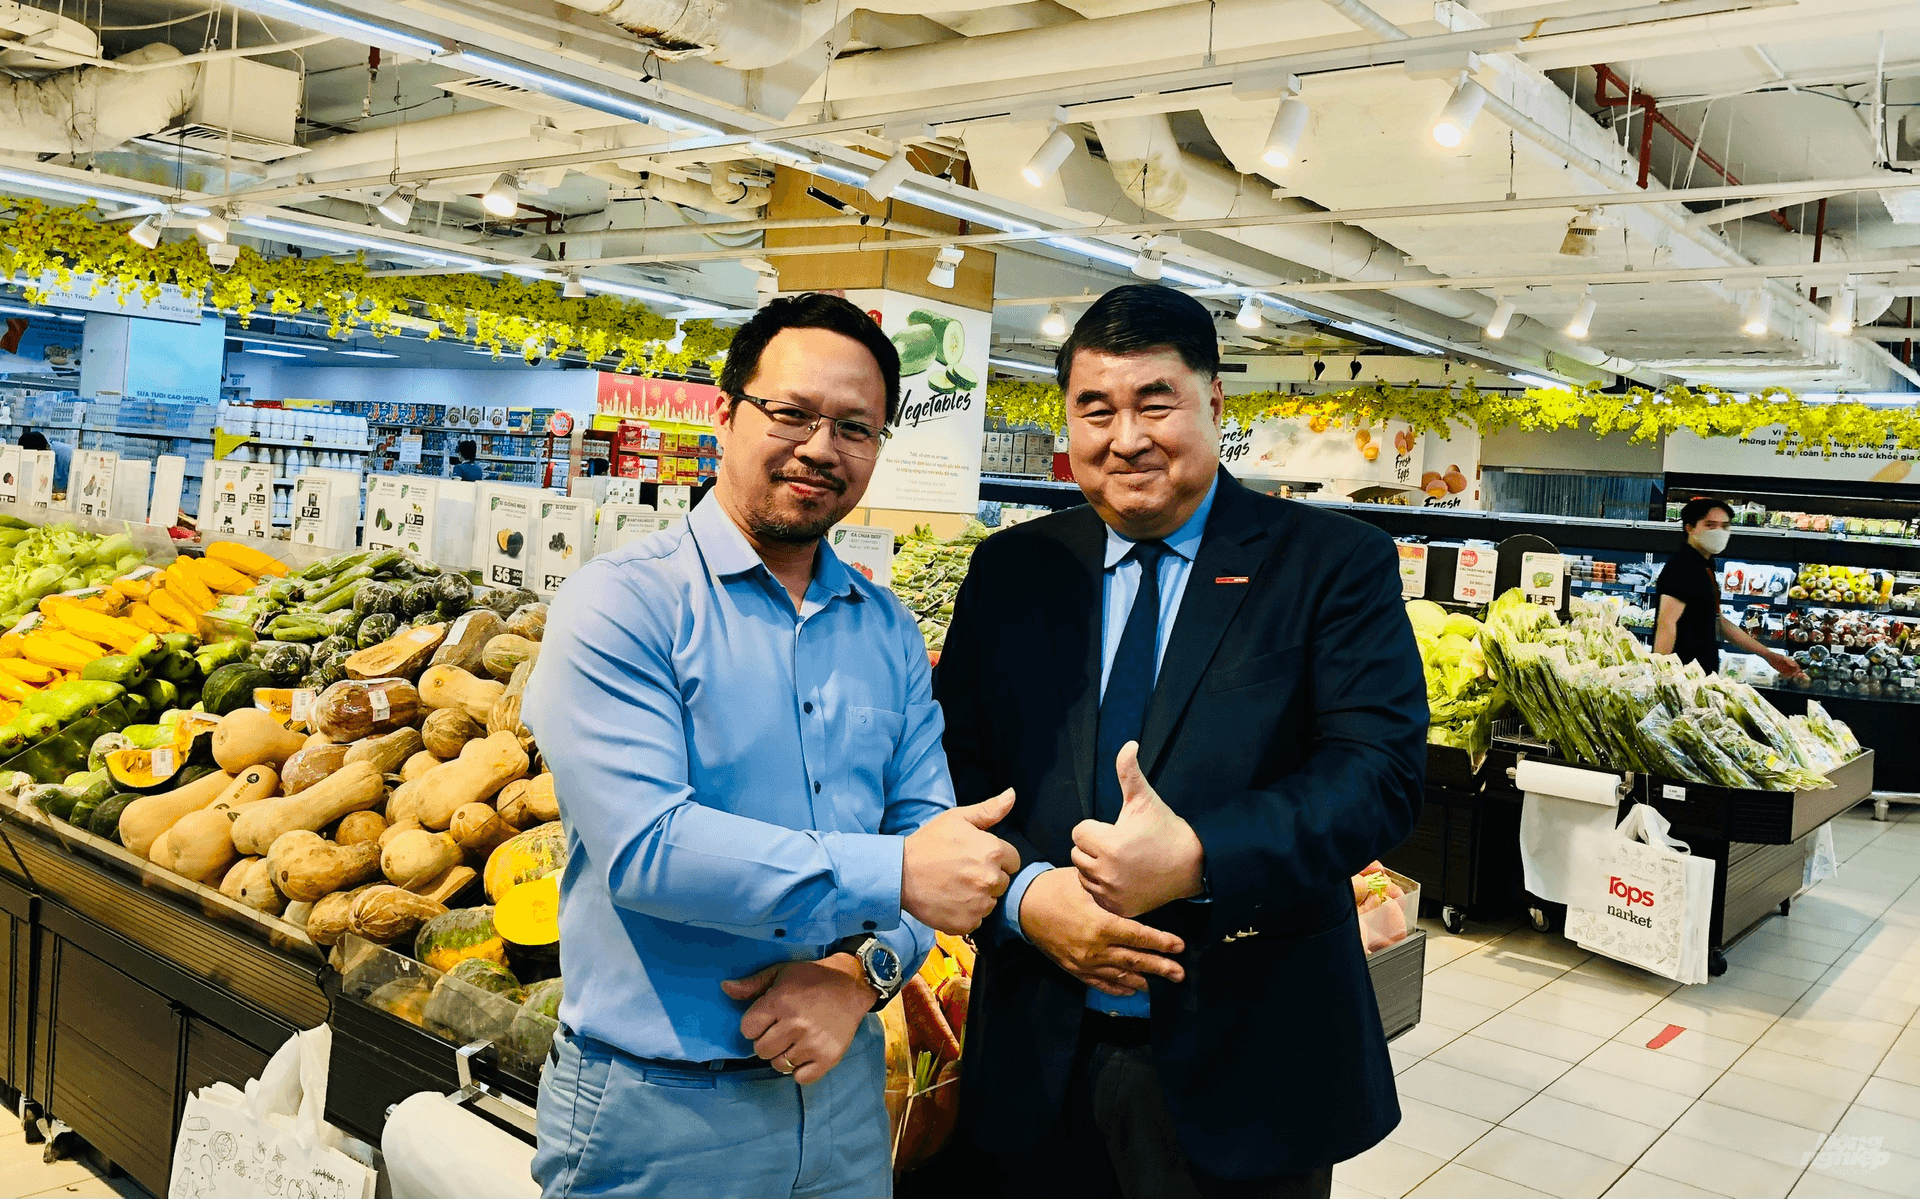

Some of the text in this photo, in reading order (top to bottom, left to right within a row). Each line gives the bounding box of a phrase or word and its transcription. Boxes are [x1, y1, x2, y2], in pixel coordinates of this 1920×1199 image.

[1219, 426, 1254, 443] resh
[1739, 438, 1766, 446] Những
[1219, 443, 1251, 463] Eggs
[1858, 451, 1874, 459] sức
[1876, 452, 1898, 460] khỏe
[1900, 453, 1915, 462] gia
[1395, 453, 1412, 469] Fresh
[1397, 468, 1410, 483] Eggs
[1423, 496, 1461, 509] Fresh
[494, 566, 510, 583] 36
[1462, 587, 1477, 597] 29
[1530, 594, 1543, 604] 15
